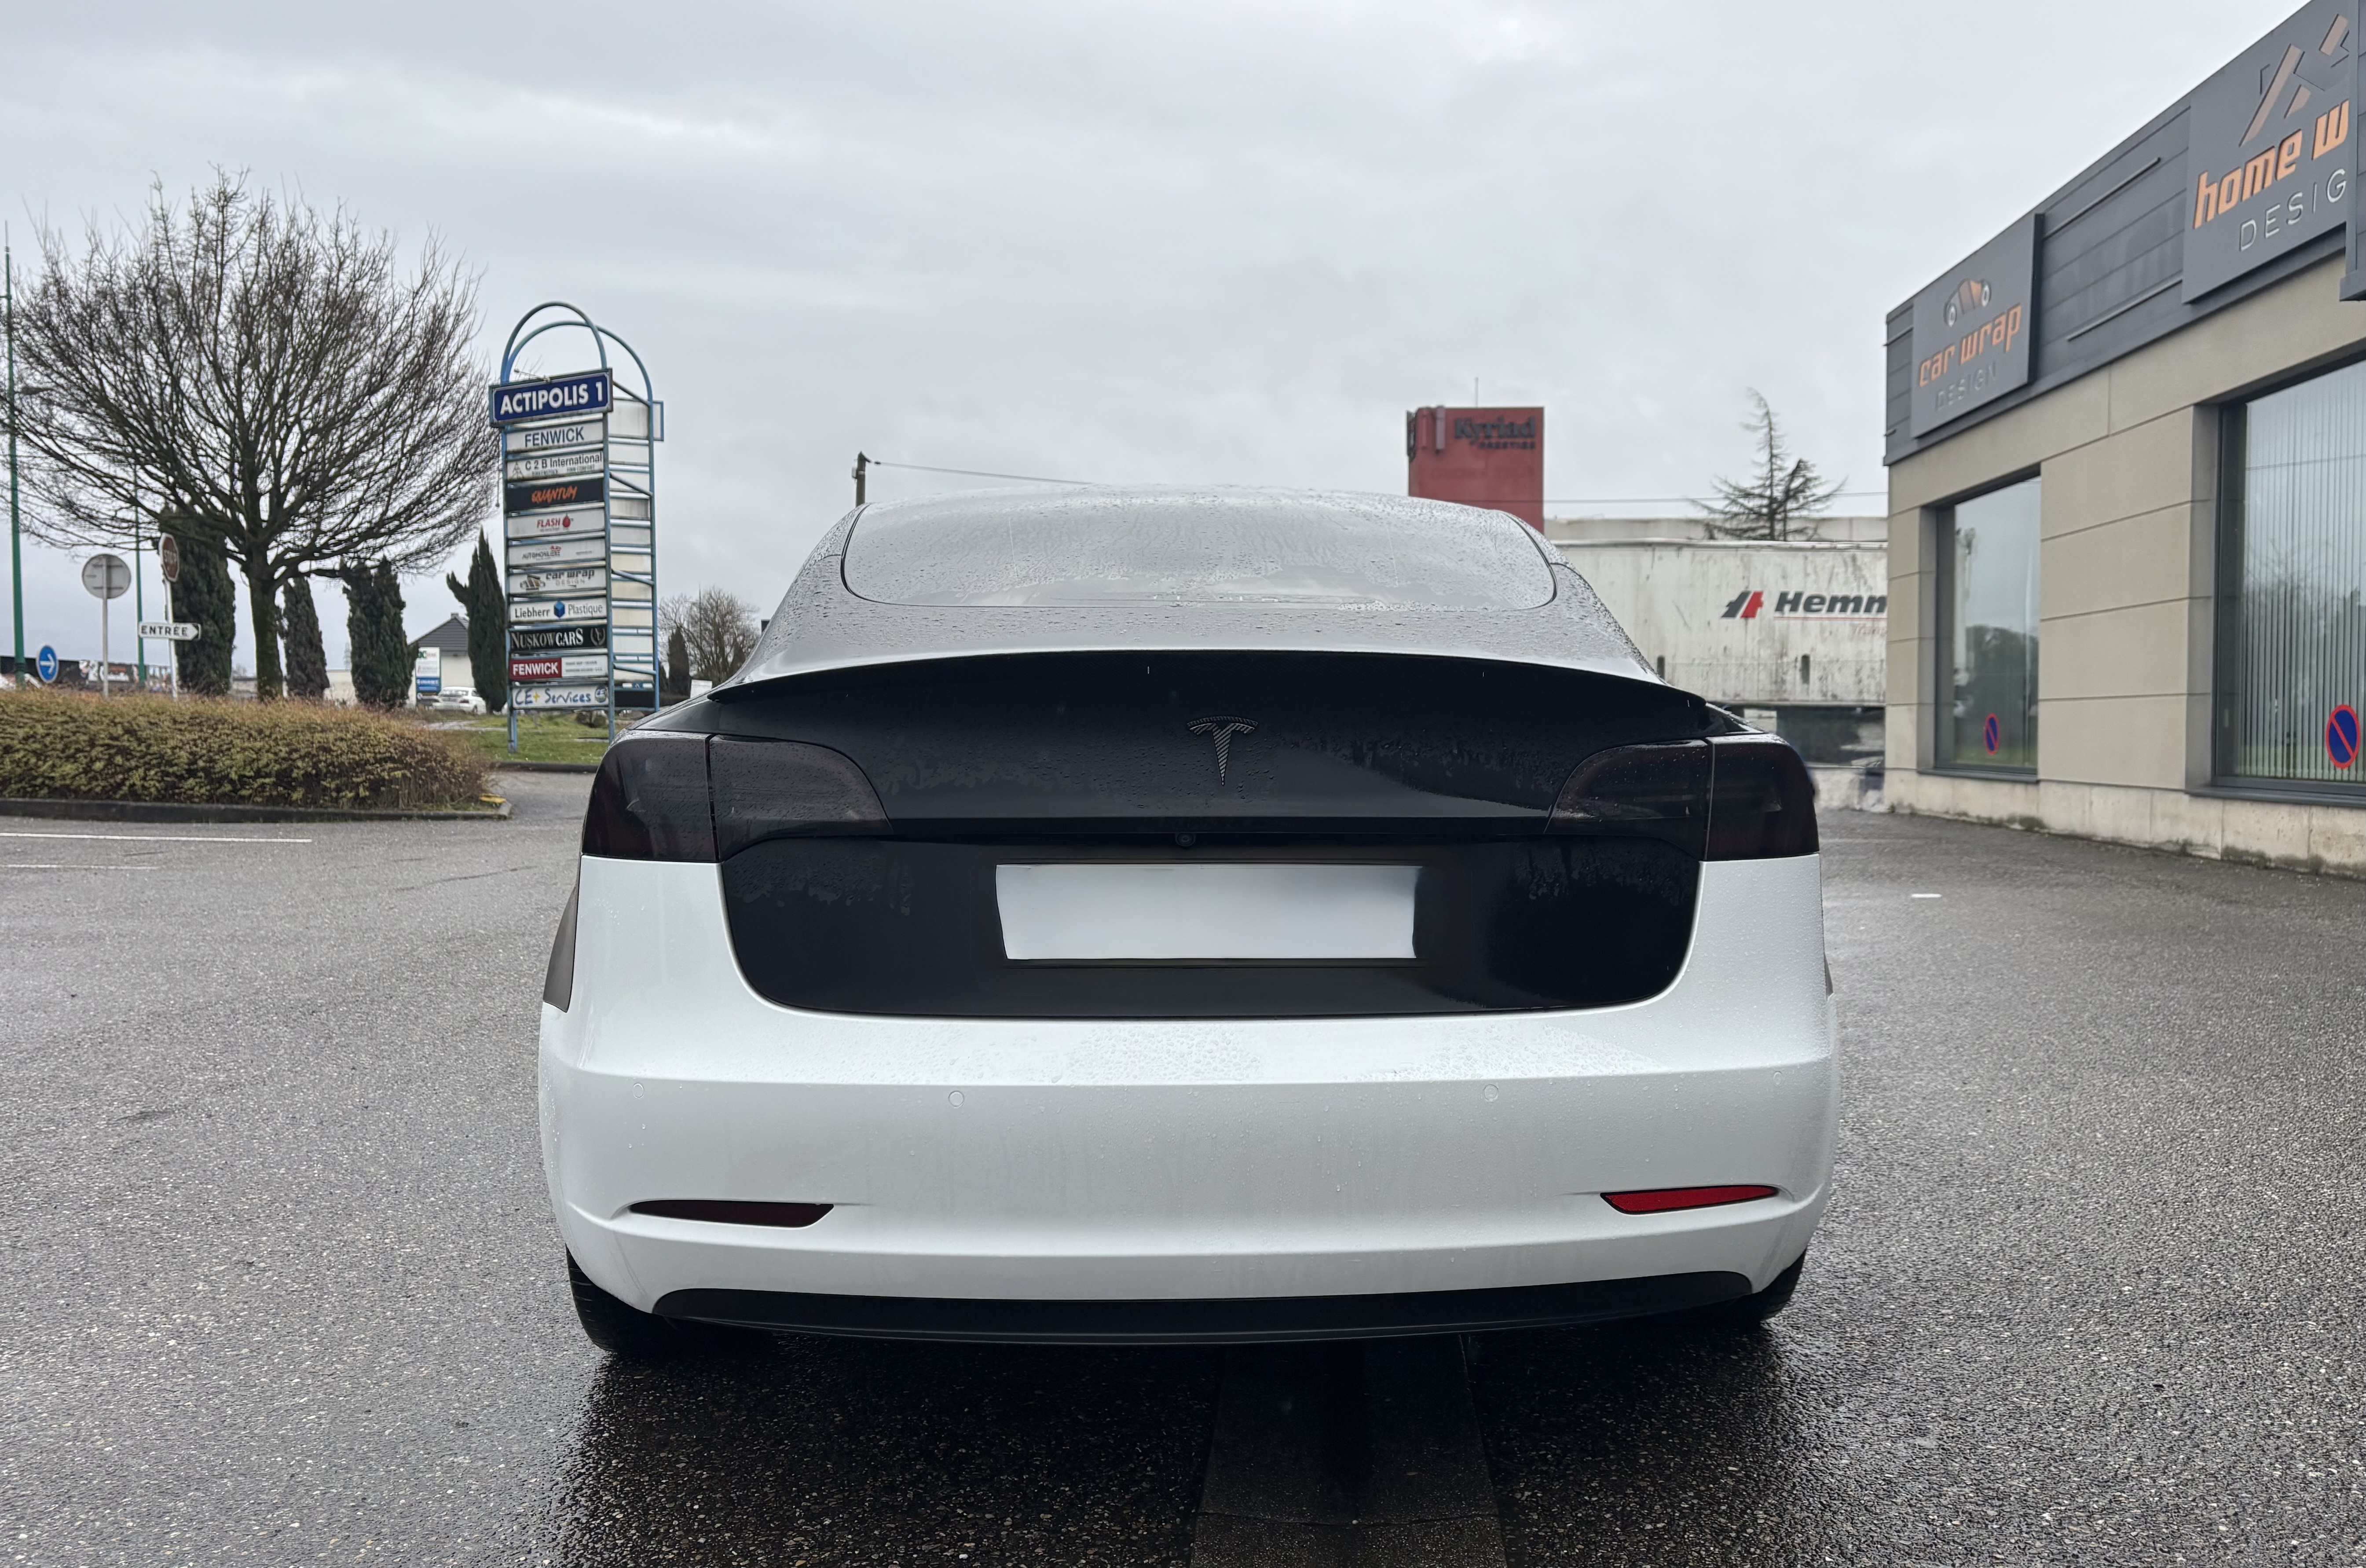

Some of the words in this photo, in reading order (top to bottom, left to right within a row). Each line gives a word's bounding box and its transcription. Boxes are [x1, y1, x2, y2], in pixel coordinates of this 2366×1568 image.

[2193, 128, 2303, 229] home
[1919, 344, 1956, 387] car
[1960, 304, 2022, 366] wrap
[1937, 361, 1996, 410] DESIGN
[500, 383, 589, 415] ACTIPOLIS
[595, 381, 603, 402] 1
[525, 427, 584, 447] FENWICK
[1454, 416, 1535, 445] Kyriad
[525, 461, 531, 471] C
[534, 460, 539, 469] 2
[542, 459, 547, 468] B
[550, 452, 602, 467] International
[531, 485, 578, 504] QUANTUM
[537, 517, 560, 528] FLASH
[567, 570, 595, 579] wrap
[515, 607, 550, 618] Liebherr
[568, 604, 603, 618] Plastique
[513, 662, 559, 676] FENWICK
[545, 687, 591, 703] Services
